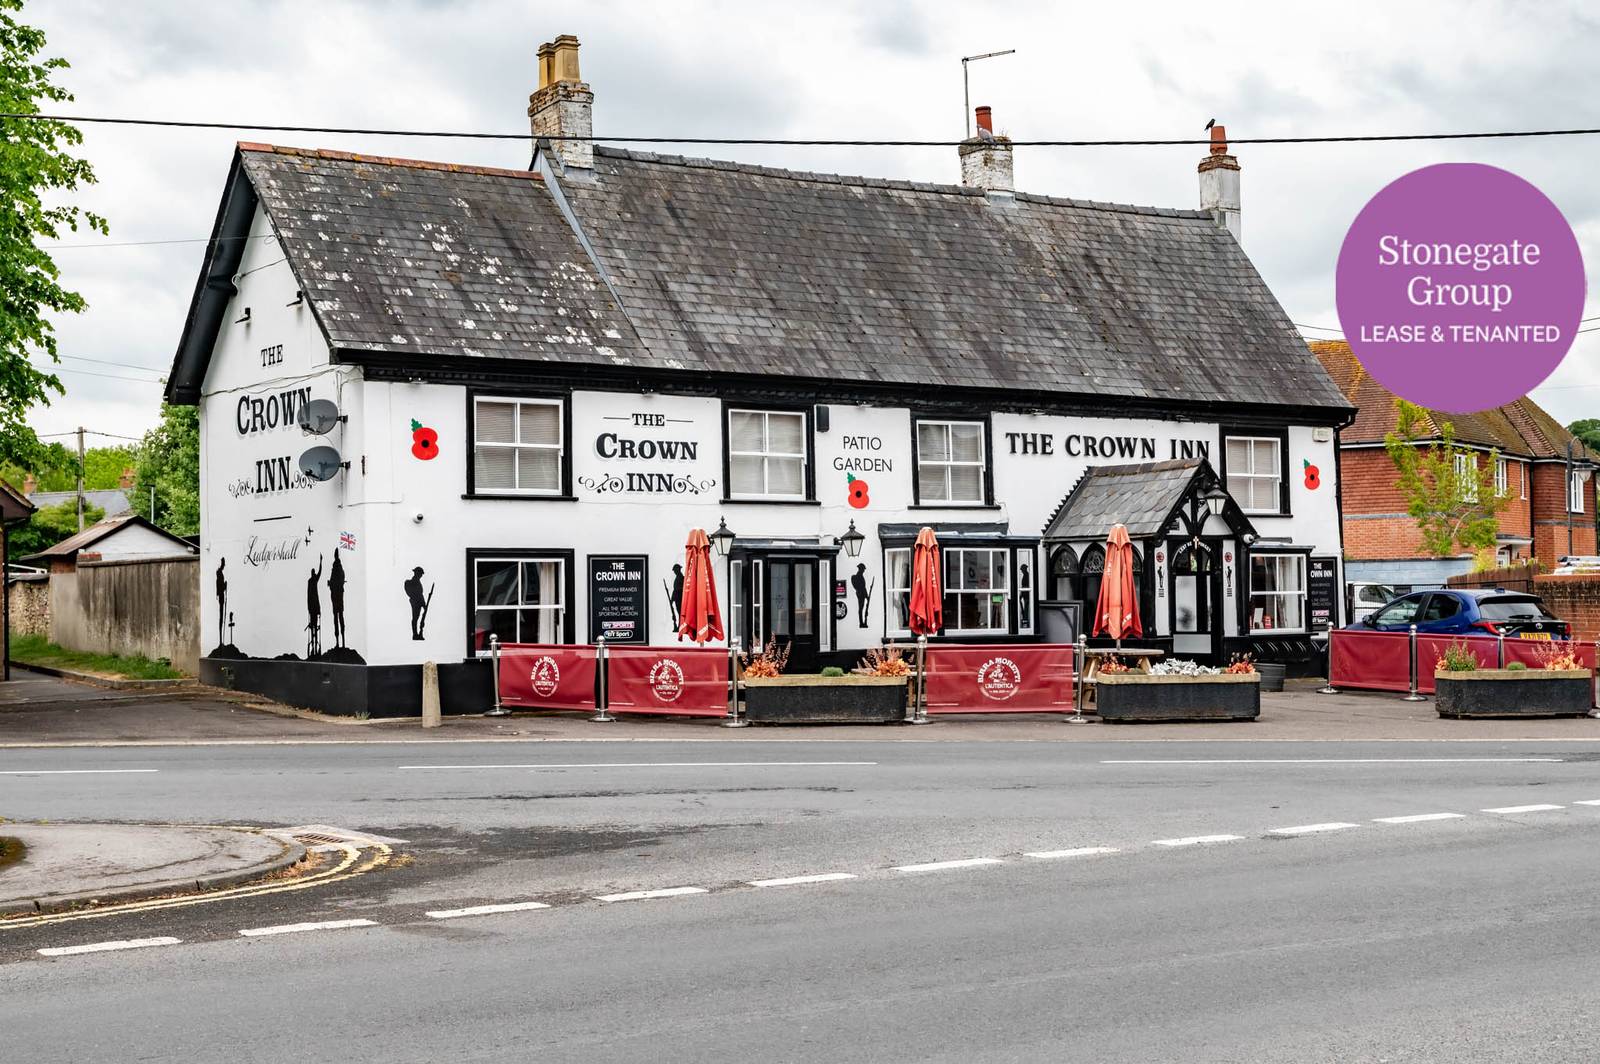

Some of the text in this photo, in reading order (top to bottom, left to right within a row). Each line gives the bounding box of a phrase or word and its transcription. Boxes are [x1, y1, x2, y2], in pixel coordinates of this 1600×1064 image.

[261, 344, 283, 367] THE
[237, 387, 312, 435] CROWN
[632, 413, 665, 427] THE
[596, 433, 698, 460] CROWN
[843, 435, 882, 451] PATIO
[1005, 432, 1210, 460] THE CROWN INN
[256, 456, 292, 494] INN
[833, 457, 893, 472] GARDEN
[626, 473, 674, 492] INN
[596, 571, 641, 581] CROWN INN
[612, 562, 625, 570] THE
[978, 657, 1021, 683] BIRRA MORETTI
